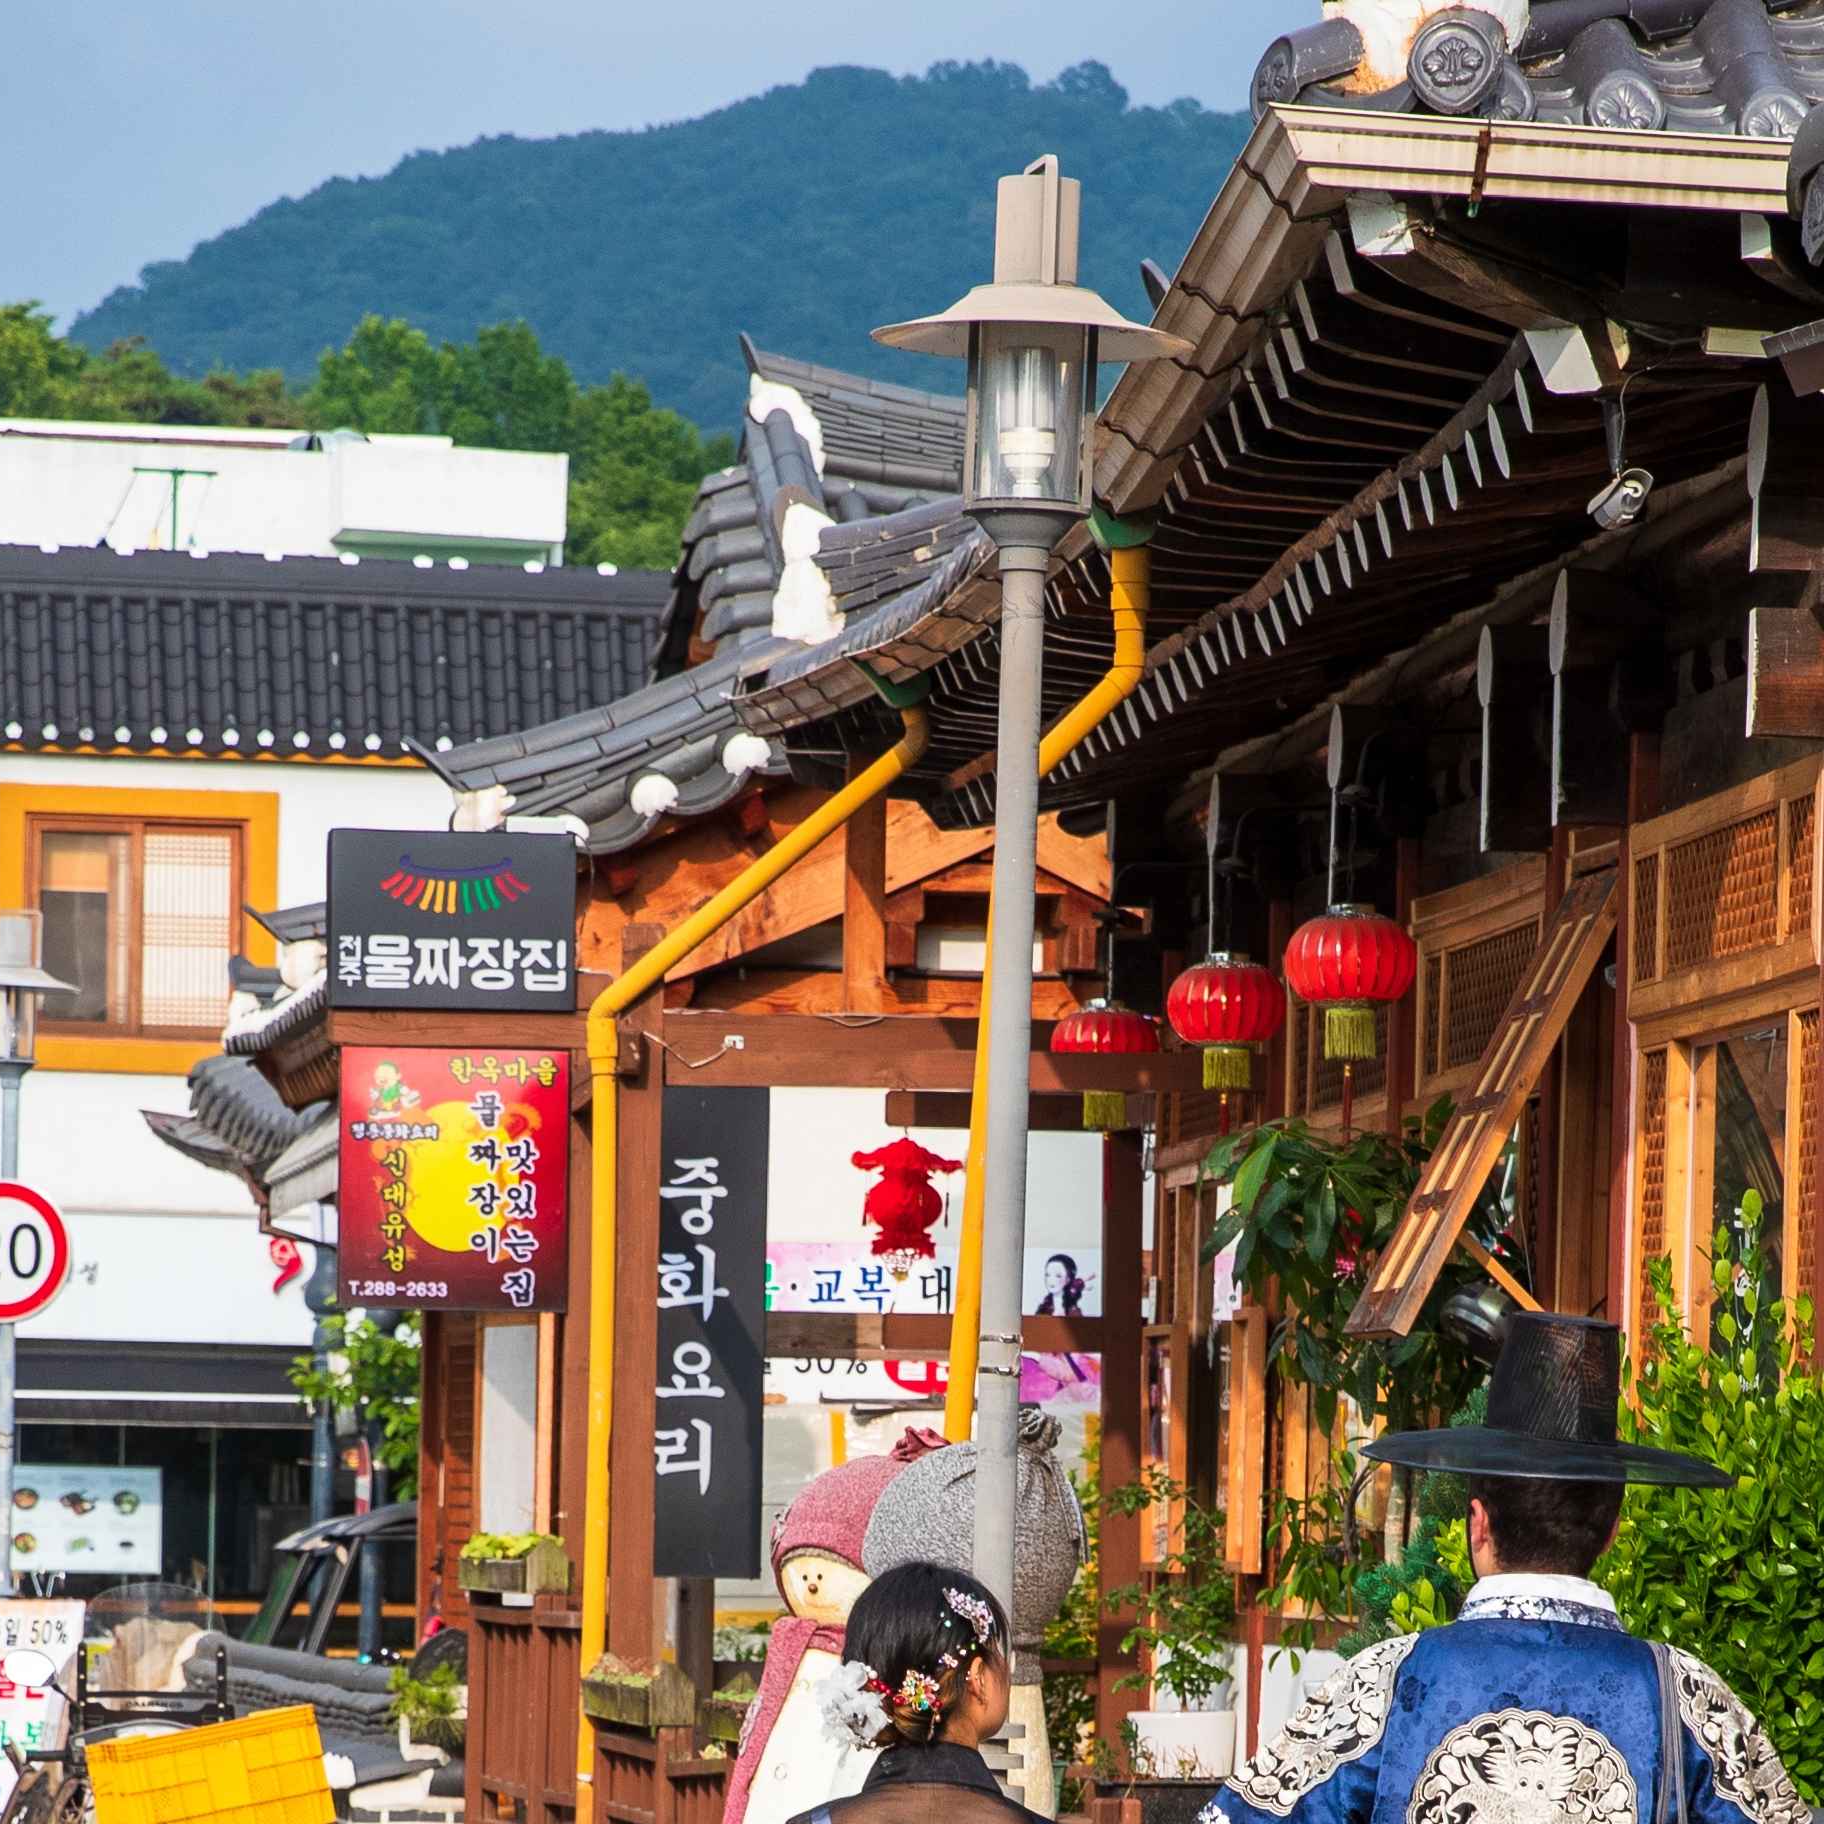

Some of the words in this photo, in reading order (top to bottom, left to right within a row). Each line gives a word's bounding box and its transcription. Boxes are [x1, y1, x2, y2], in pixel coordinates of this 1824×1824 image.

[338, 935, 362, 987] 전주
[363, 934, 567, 991] 물짜장집
[449, 1056, 558, 1086] 한옥마을
[469, 1094, 501, 1260] 물짜장이
[502, 1139, 537, 1305] 맛있는집
[348, 1280, 448, 1298] T.288-2633
[809, 1266, 890, 1313] 교복
[654, 1157, 729, 1494] 중화요리
[30, 1619, 70, 1646] 50%
